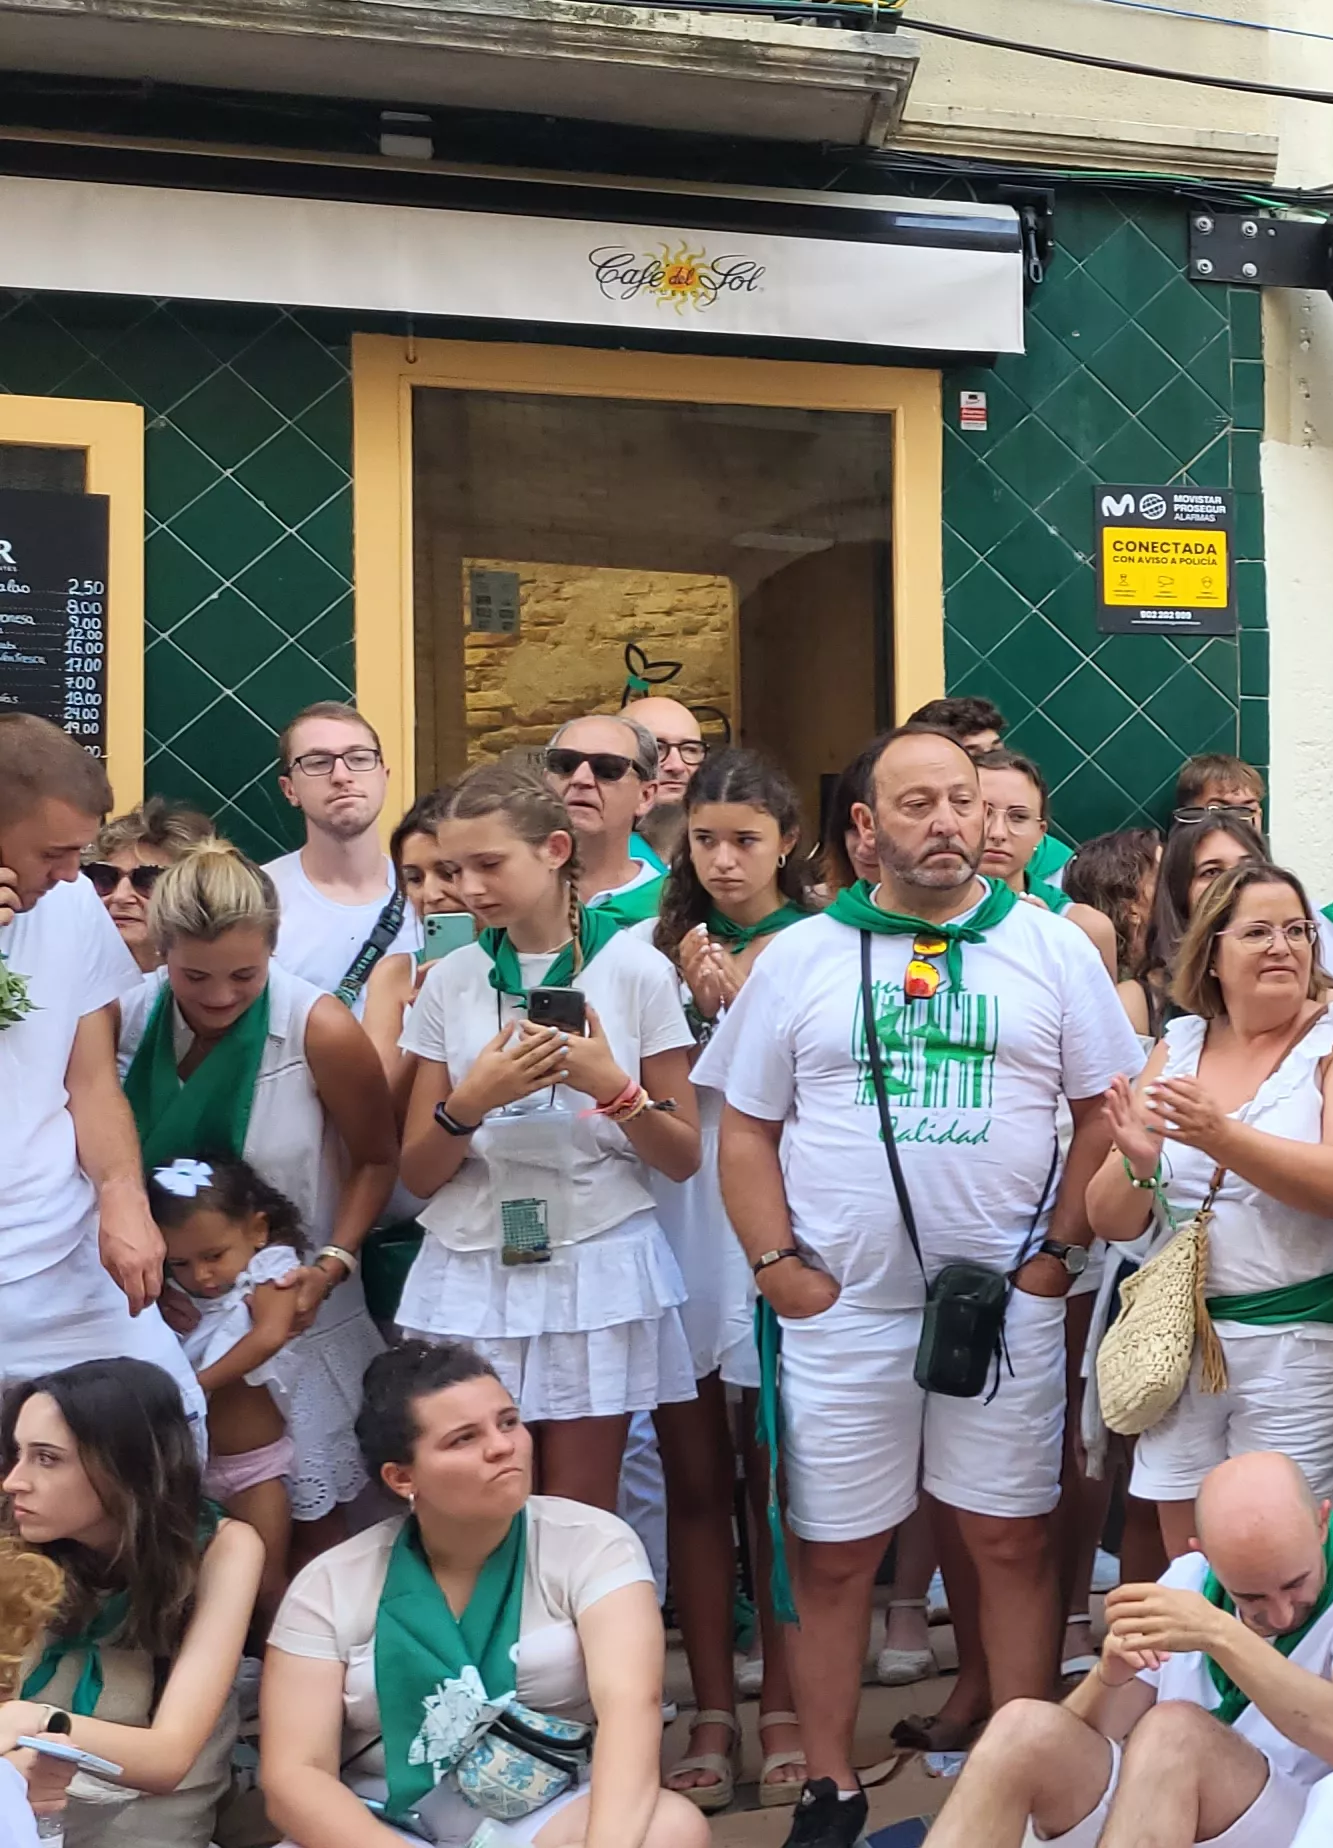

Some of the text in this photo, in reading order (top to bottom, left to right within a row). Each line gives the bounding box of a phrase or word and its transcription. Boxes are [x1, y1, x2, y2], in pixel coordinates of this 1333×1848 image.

[588, 245, 767, 306] Café del Sol
[1173, 494, 1222, 504] MOVISTAR
[1173, 503, 1226, 514] PROSEGUR
[1173, 513, 1217, 522] ALARMAS
[1112, 540, 1218, 556] CONECTADA
[1112, 555, 1218, 566] CON AVISO A POLICÍA
[66, 599, 102, 615] 8.00
[69, 615, 102, 629] 9.00
[65, 627, 103, 640] 12.00
[63, 640, 104, 655] 16.00
[64, 657, 102, 673] 17.00
[64, 691, 102, 706] 18.00
